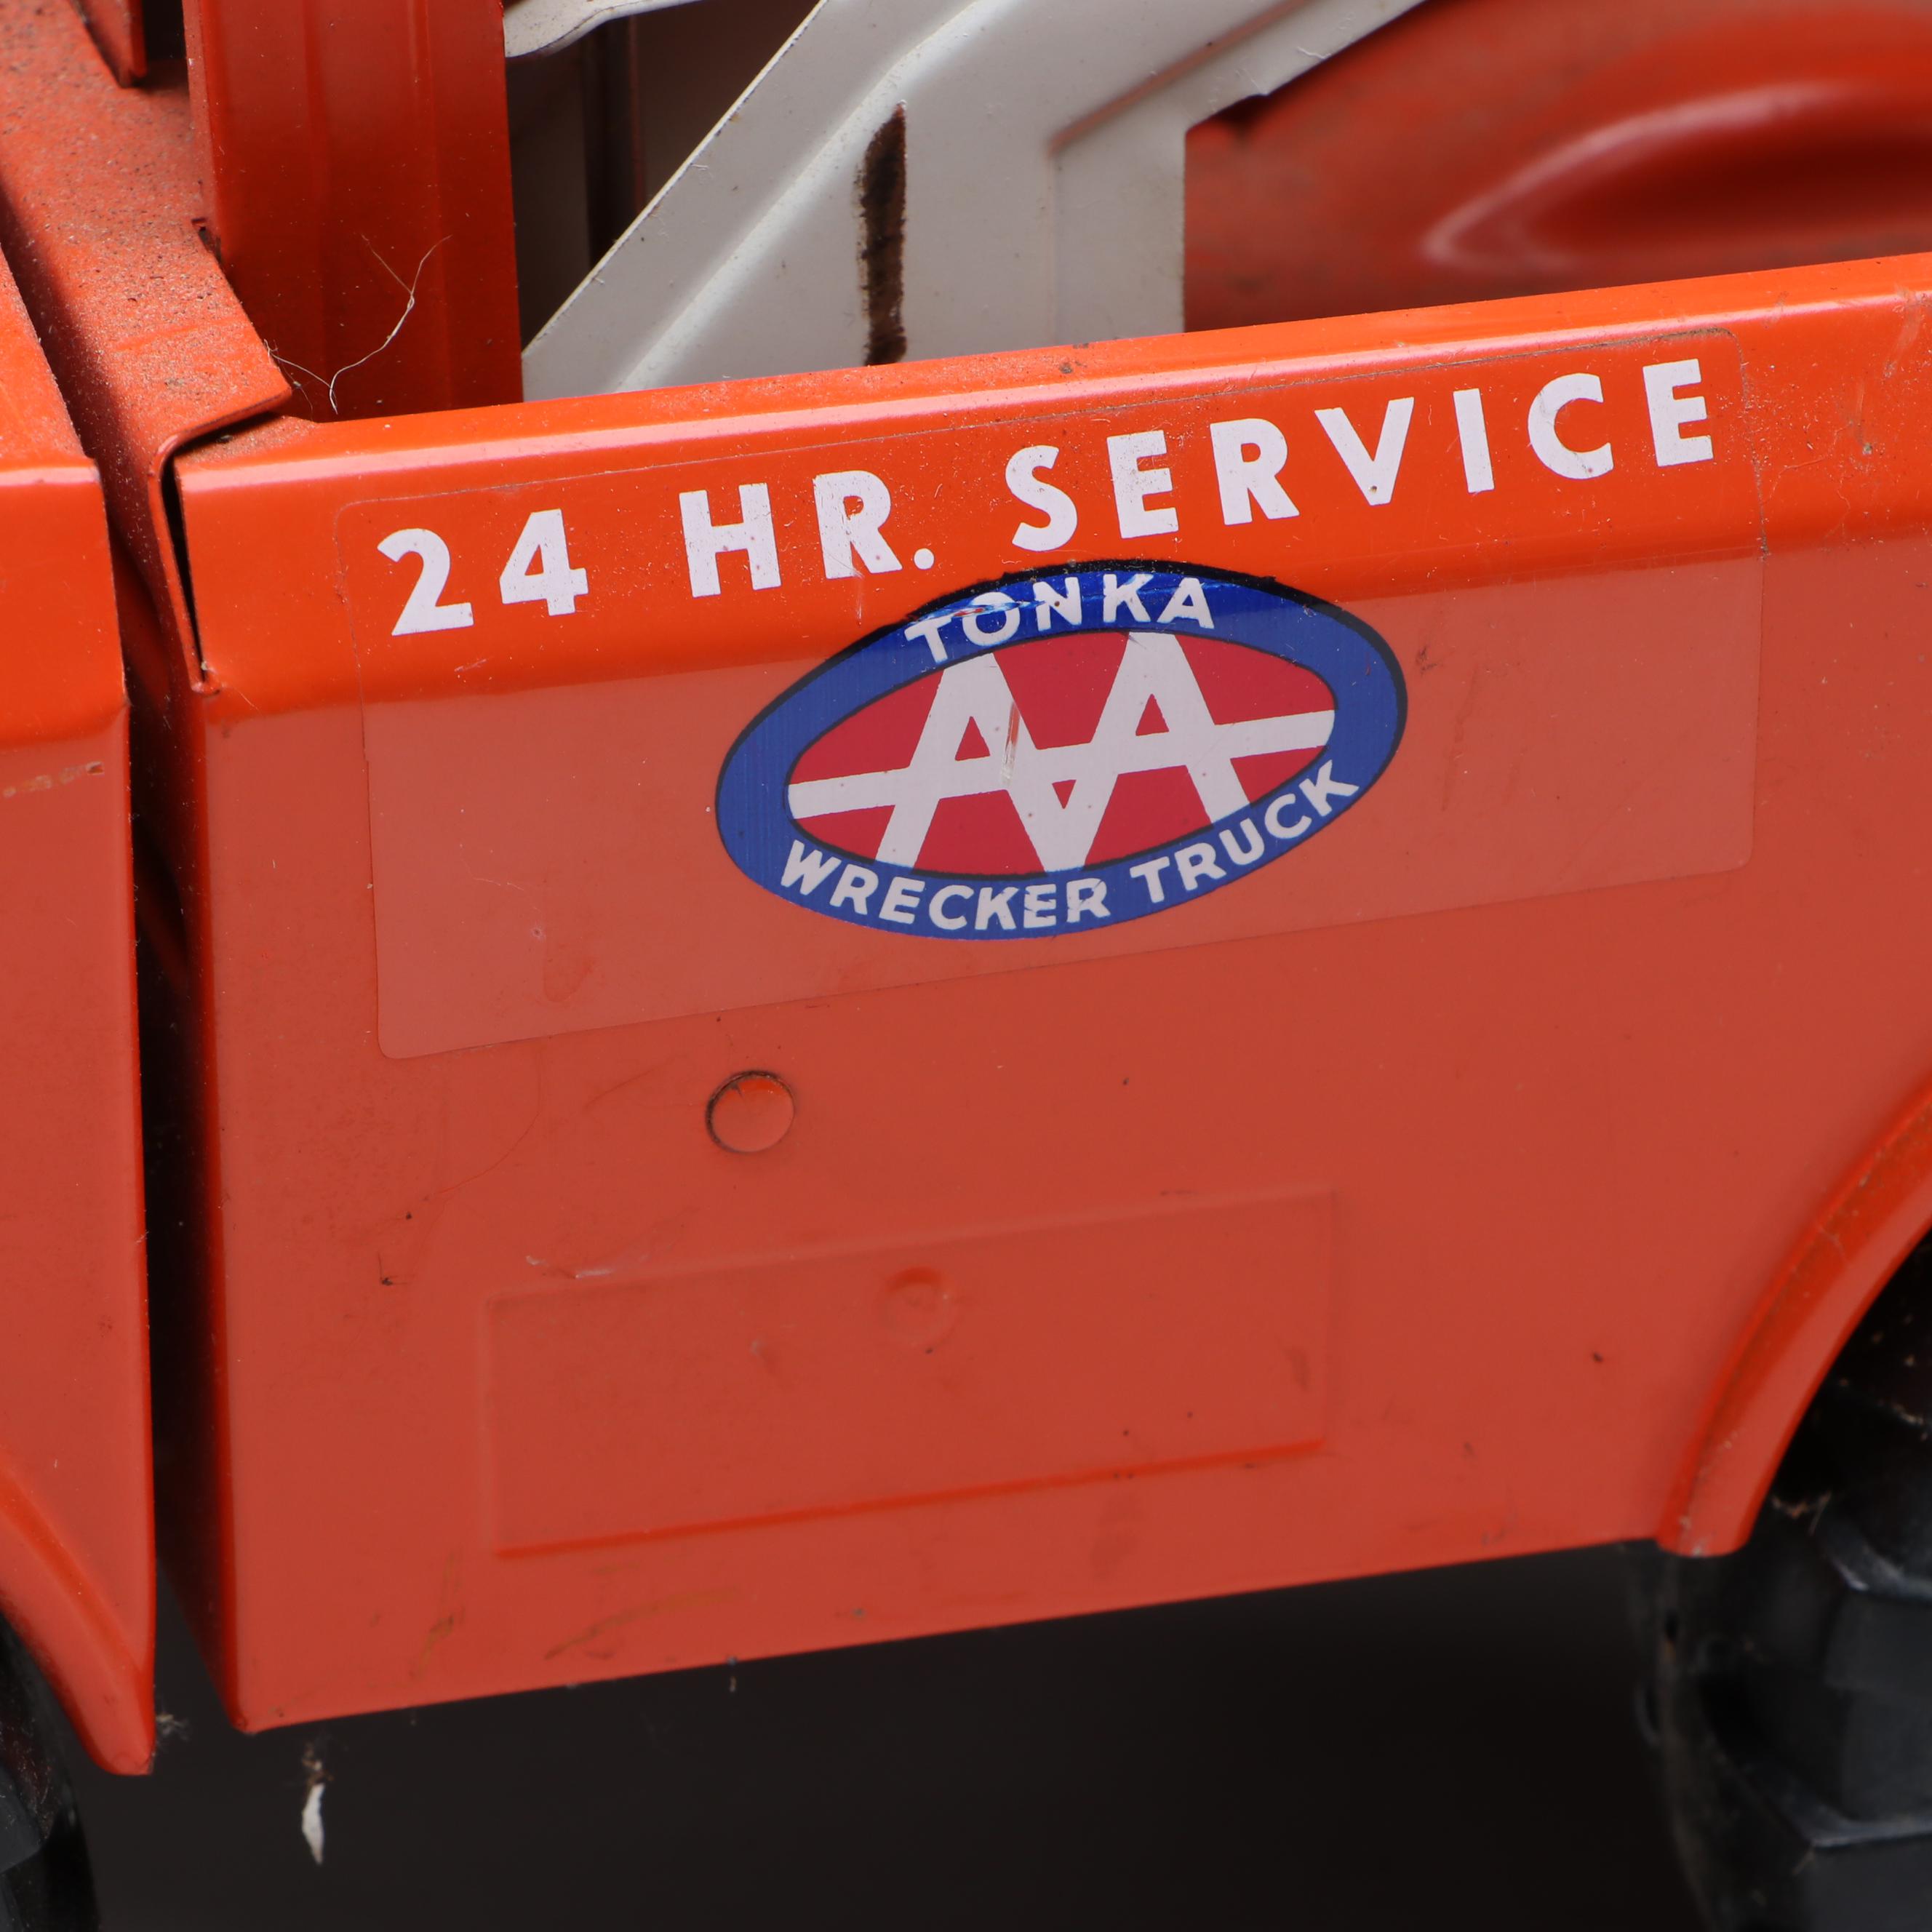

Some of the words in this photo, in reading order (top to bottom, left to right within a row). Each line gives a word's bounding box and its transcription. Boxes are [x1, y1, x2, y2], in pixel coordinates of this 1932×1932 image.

[377, 509, 589, 636] 24
[679, 470, 935, 598] HR.
[1005, 358, 1715, 552] SERVICE
[904, 572, 1215, 663] TONKA
[781, 839, 1111, 930] WRECKER
[1130, 759, 1360, 903] TRUCK
